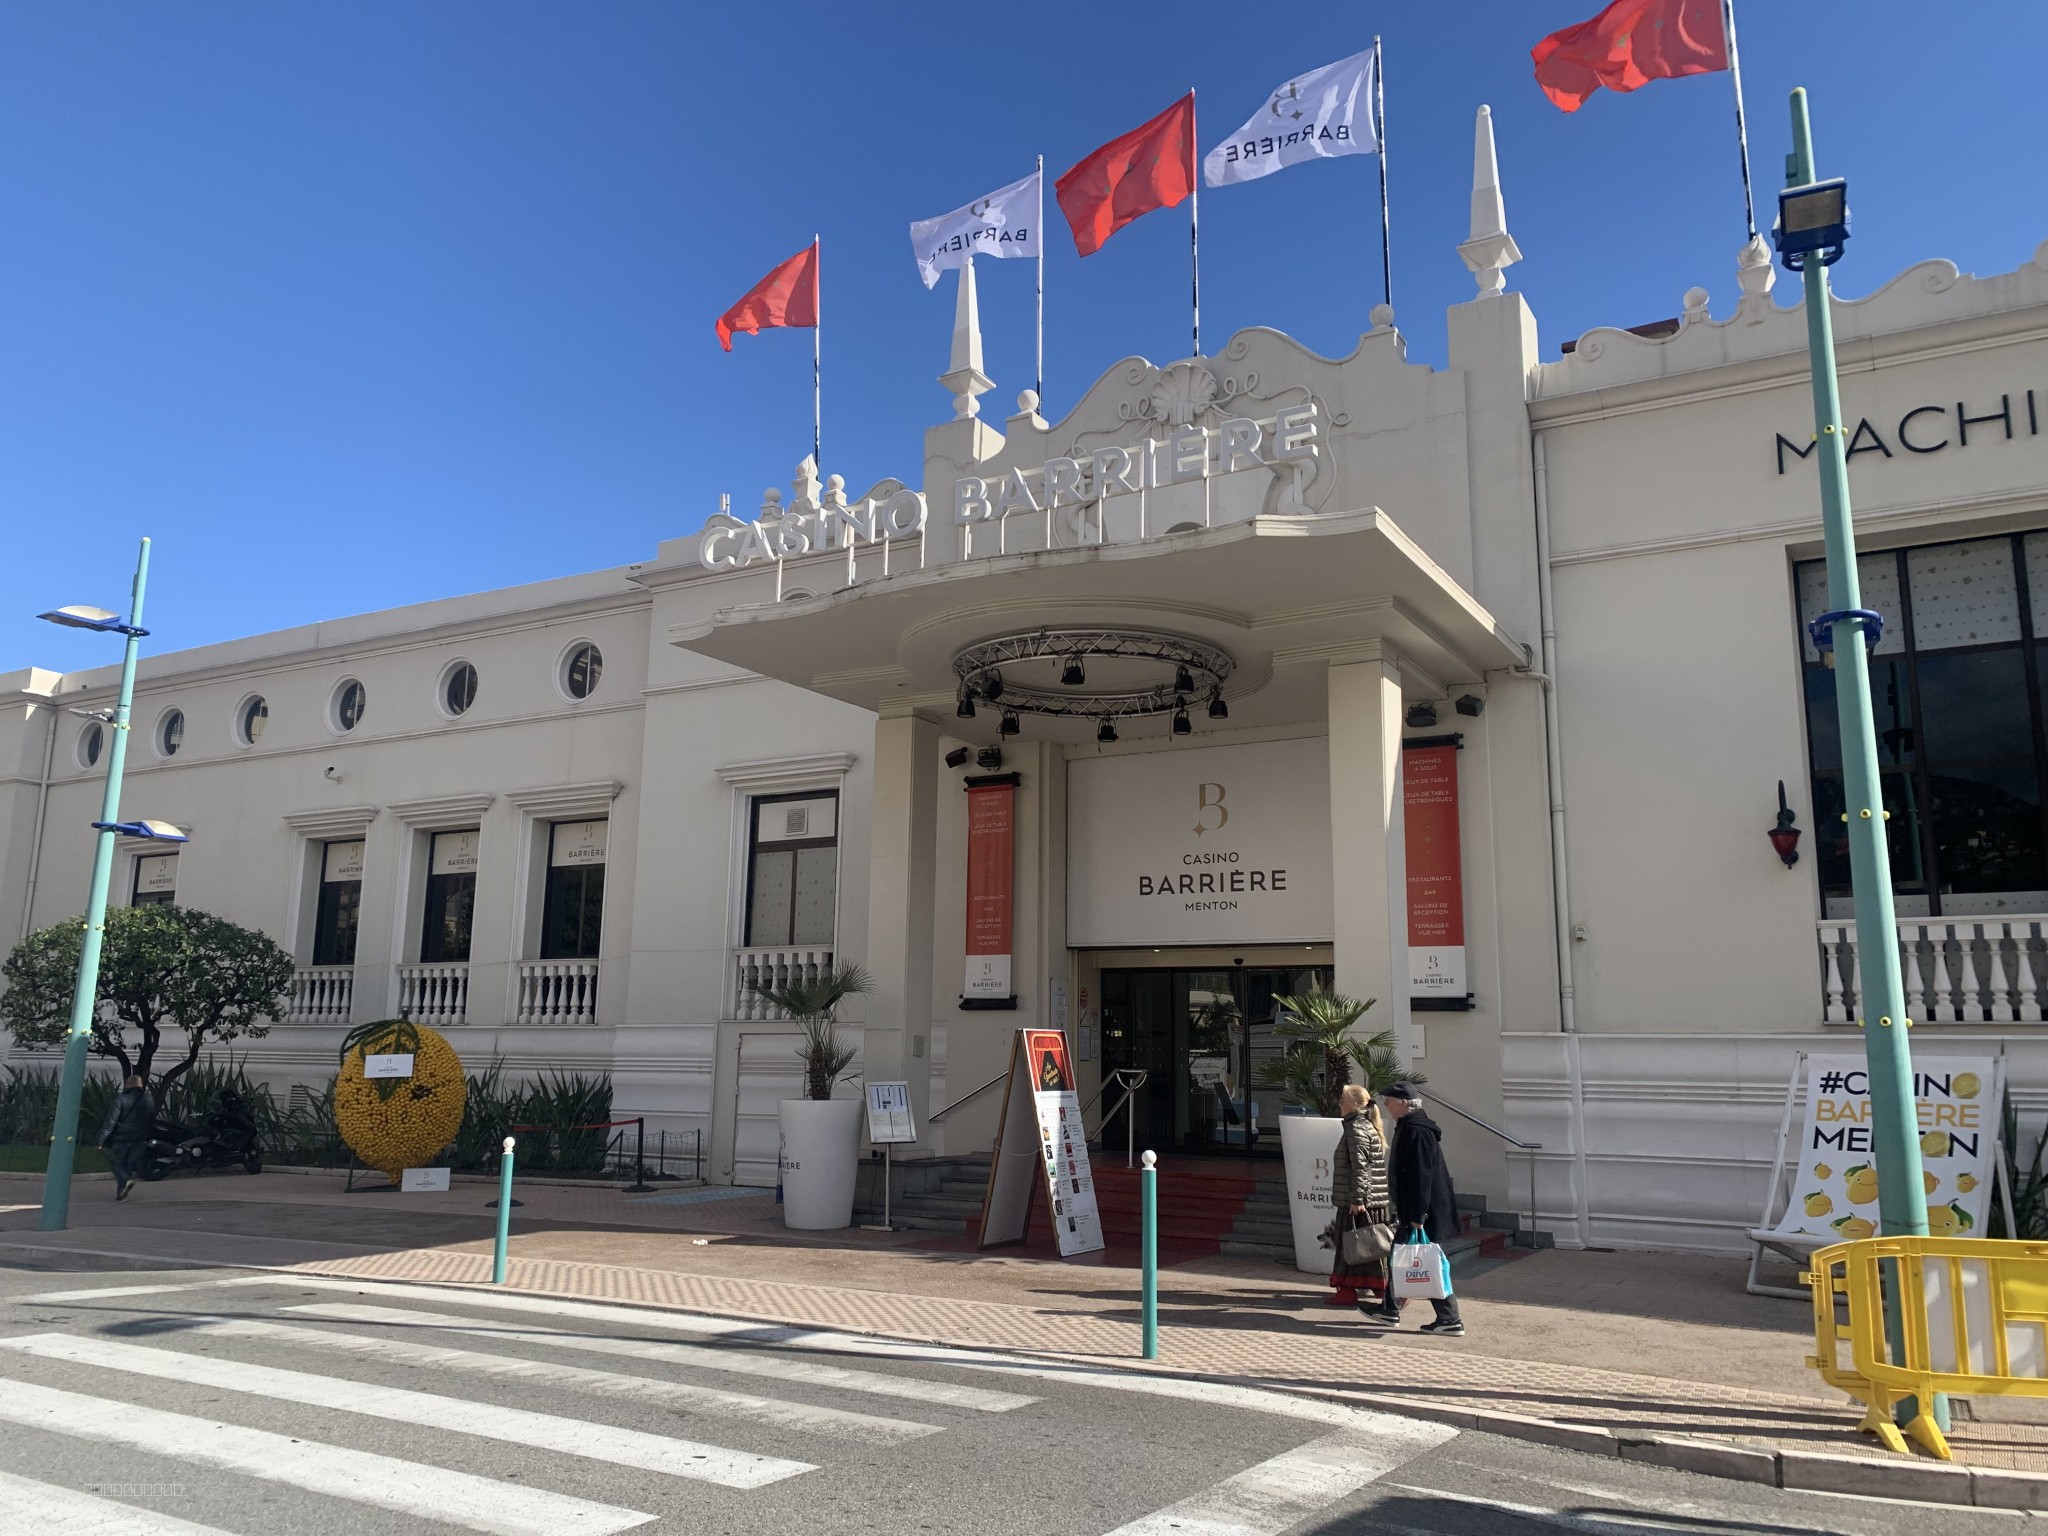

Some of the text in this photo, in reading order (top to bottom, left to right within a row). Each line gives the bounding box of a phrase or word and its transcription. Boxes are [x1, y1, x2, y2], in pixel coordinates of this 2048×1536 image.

[699, 490, 927, 571] CASINO
[1183, 852, 1239, 865] CASINO
[1140, 869, 1287, 895] BARRIÈRE
[1185, 901, 1238, 911] MENTON
